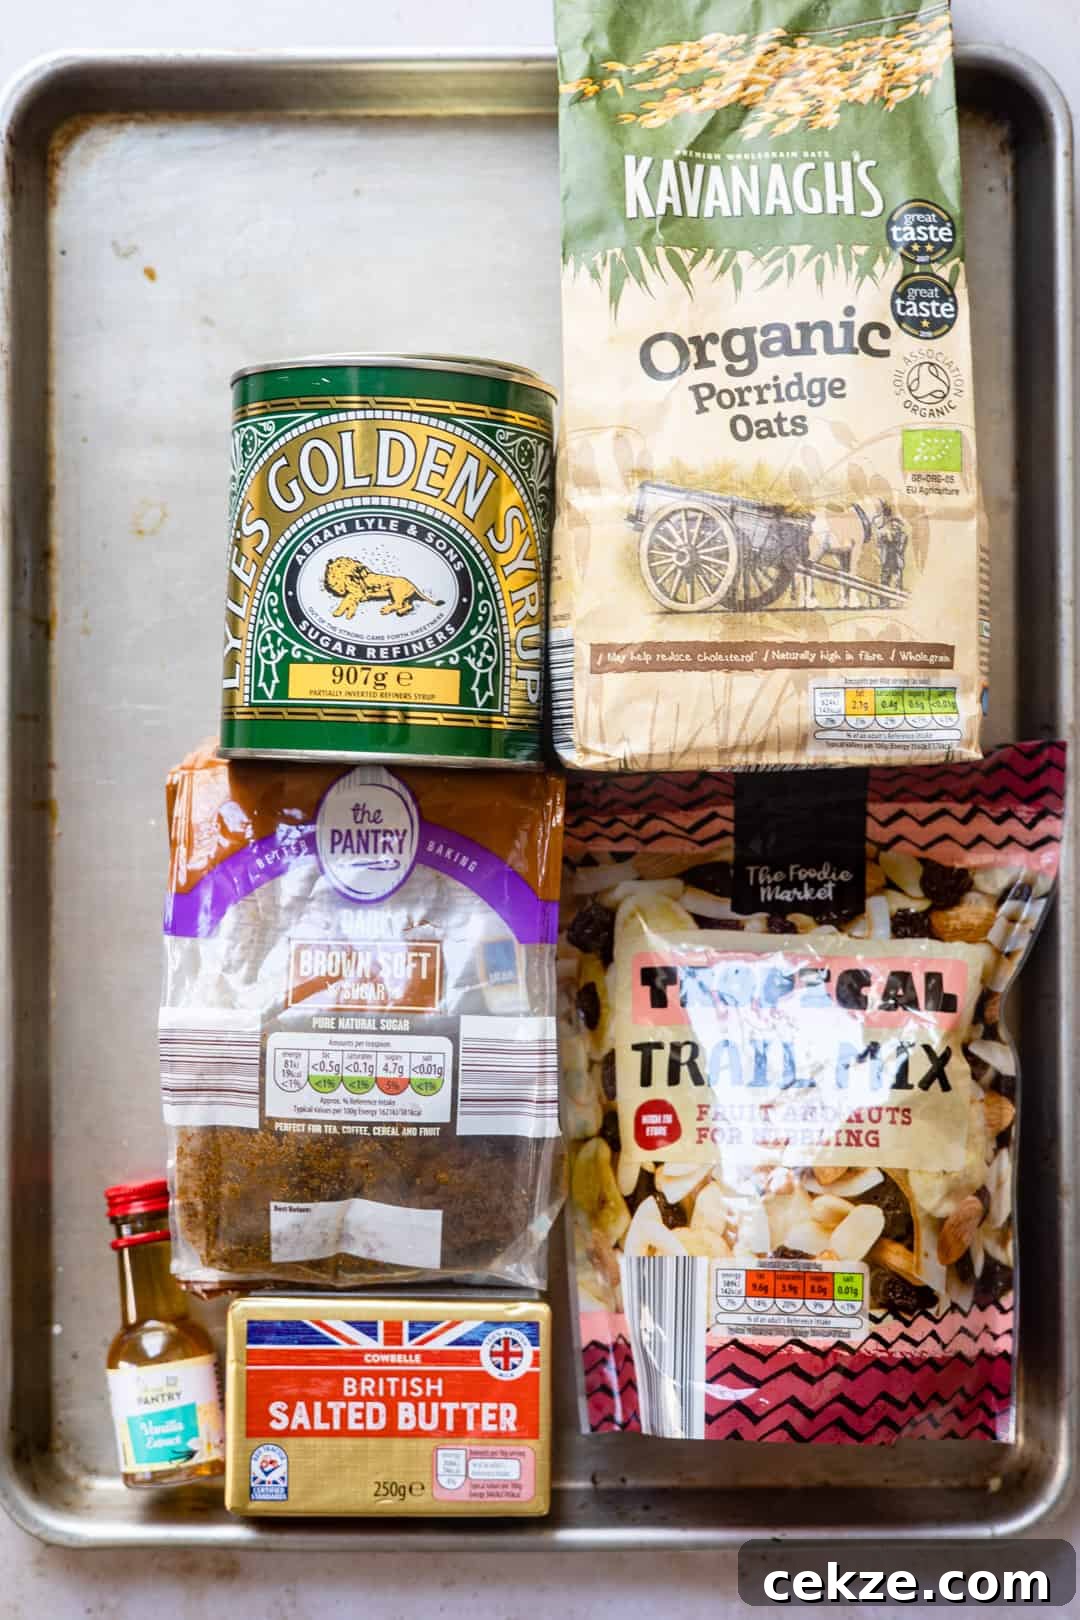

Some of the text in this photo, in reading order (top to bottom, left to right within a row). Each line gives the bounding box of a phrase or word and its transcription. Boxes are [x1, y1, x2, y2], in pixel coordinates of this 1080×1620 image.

[623, 150, 886, 219] KAVANAGH'S
[904, 213, 937, 225] great
[891, 224, 953, 243] taste
[907, 287, 940, 300] great
[894, 297, 956, 319] taste
[638, 305, 891, 382] Organic
[893, 348, 965, 398] SOIL ASSOCIATION
[688, 372, 847, 415] Porridge
[903, 399, 957, 419] ORGANIC
[729, 412, 809, 442] Oats
[294, 517, 464, 574] ABRAM LYLE & SONS
[267, 428, 498, 521] GOLDEN
[483, 505, 541, 706] SYRUP
[299, 620, 458, 660] SUGAR REFINERS
[630, 651, 652, 664] help
[655, 653, 692, 662] reduce
[771, 650, 817, 664] Naturally
[820, 650, 841, 664] high
[331, 665, 389, 691] 907g
[350, 802, 384, 825] the
[330, 828, 408, 856] PANTRY
[425, 840, 479, 872] BAKING
[746, 862, 854, 887] The Foodie
[760, 882, 837, 904] Market
[300, 948, 432, 982] BROWN SOFT
[311, 1015, 411, 1032] PURE NATURAL SUGAR
[311, 1061, 341, 1075] <0.5g
[345, 1062, 375, 1077] <0.1g
[382, 1062, 405, 1077] 4.7g
[411, 1064, 443, 1078] <0.01g
[631, 1039, 952, 1093] TRAIL MIX
[315, 1078, 336, 1089] <1%
[348, 1079, 370, 1090] <1%
[274, 1121, 441, 1138] PERFECT FOR TEA, COFFEE, CEREAL AND FRUIT
[695, 1127, 744, 1146] FOR
[364, 1353, 422, 1365] COWBELLE
[344, 1377, 445, 1398] BRITISH
[269, 1401, 518, 1432] SALTED BUTTER
[373, 1481, 407, 1501] 250g
